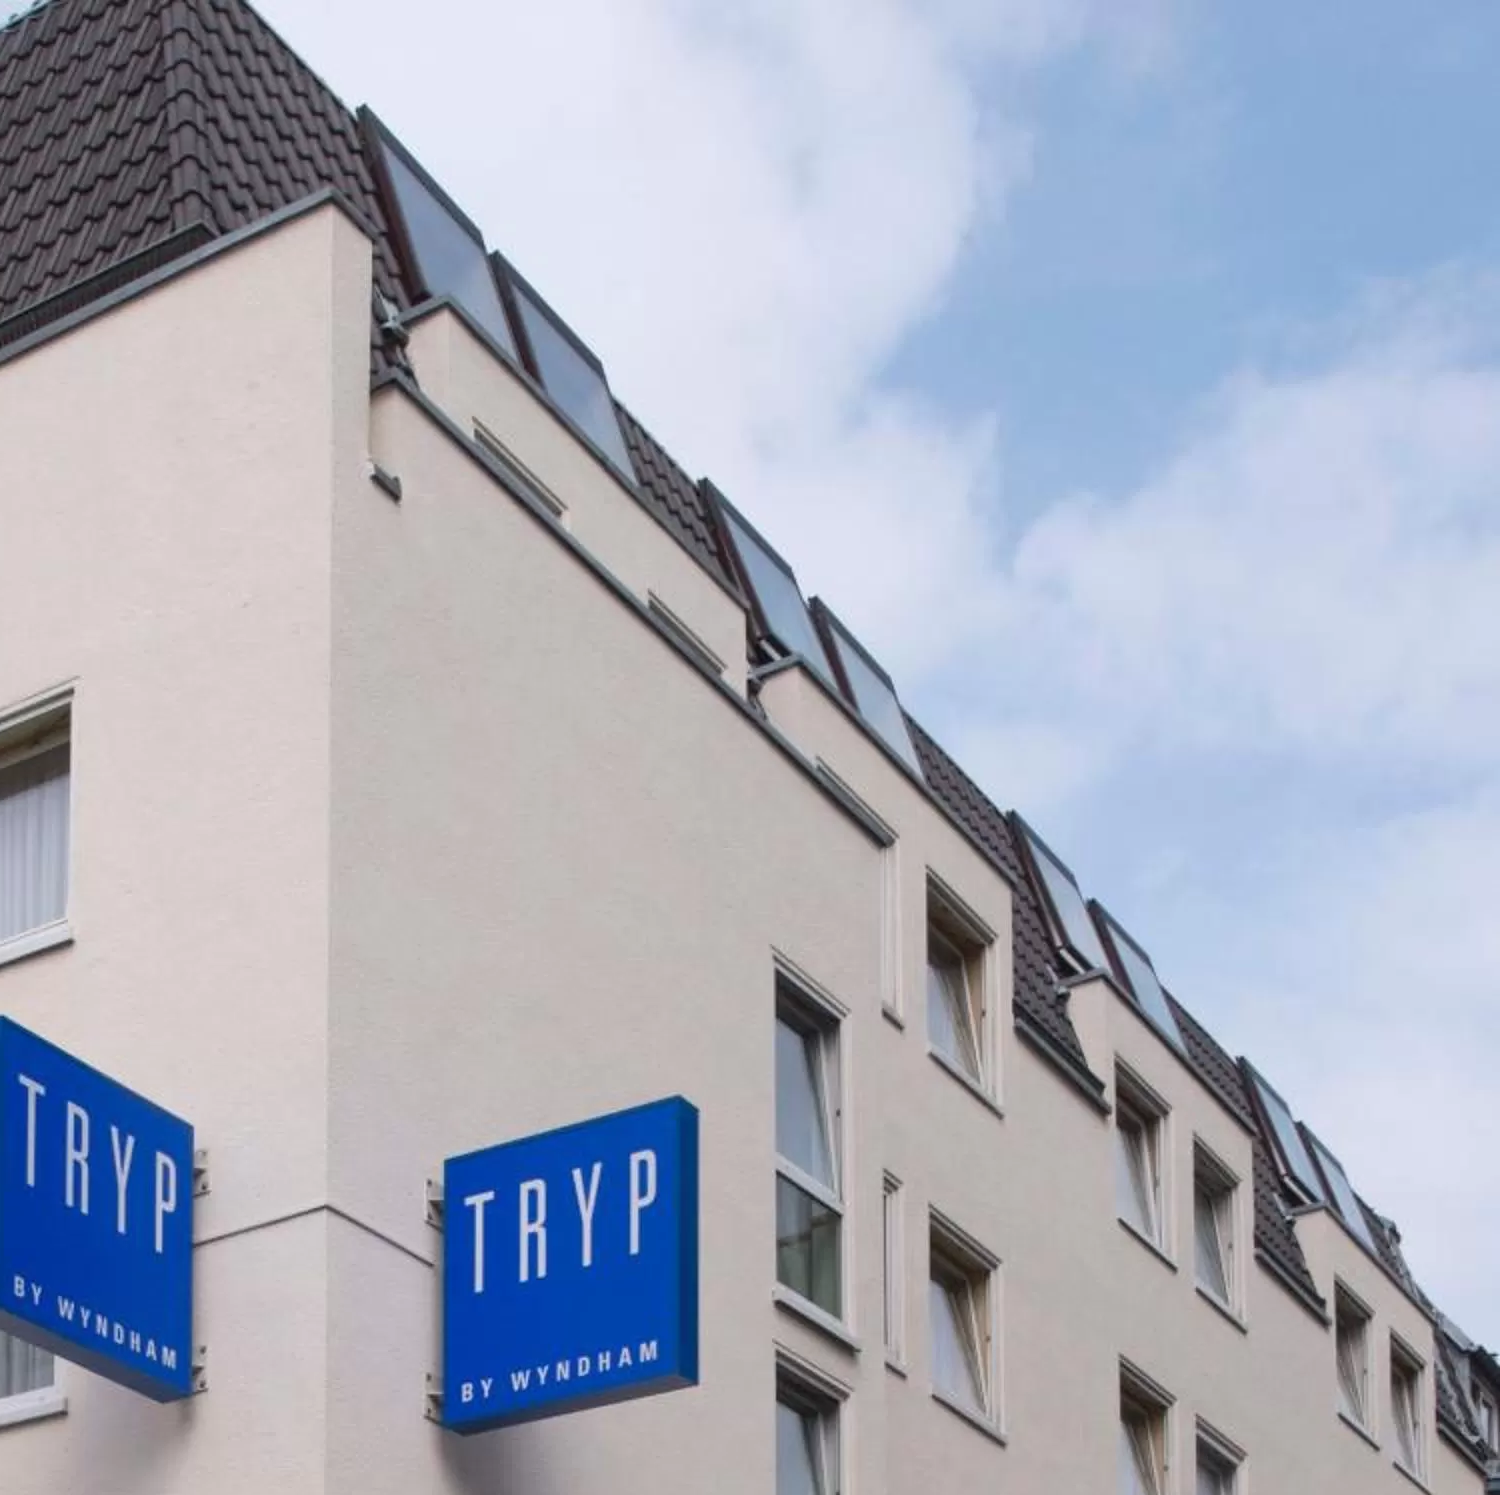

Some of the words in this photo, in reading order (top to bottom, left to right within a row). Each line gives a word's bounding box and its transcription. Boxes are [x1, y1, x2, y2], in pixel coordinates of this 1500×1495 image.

[18, 1073, 177, 1254] TRYP
[464, 1149, 657, 1293] TRYP
[14, 1275, 42, 1305] BY
[58, 1297, 178, 1370] WYNDHAM
[461, 1380, 493, 1403] BY
[511, 1340, 657, 1393] WYNDHAM
